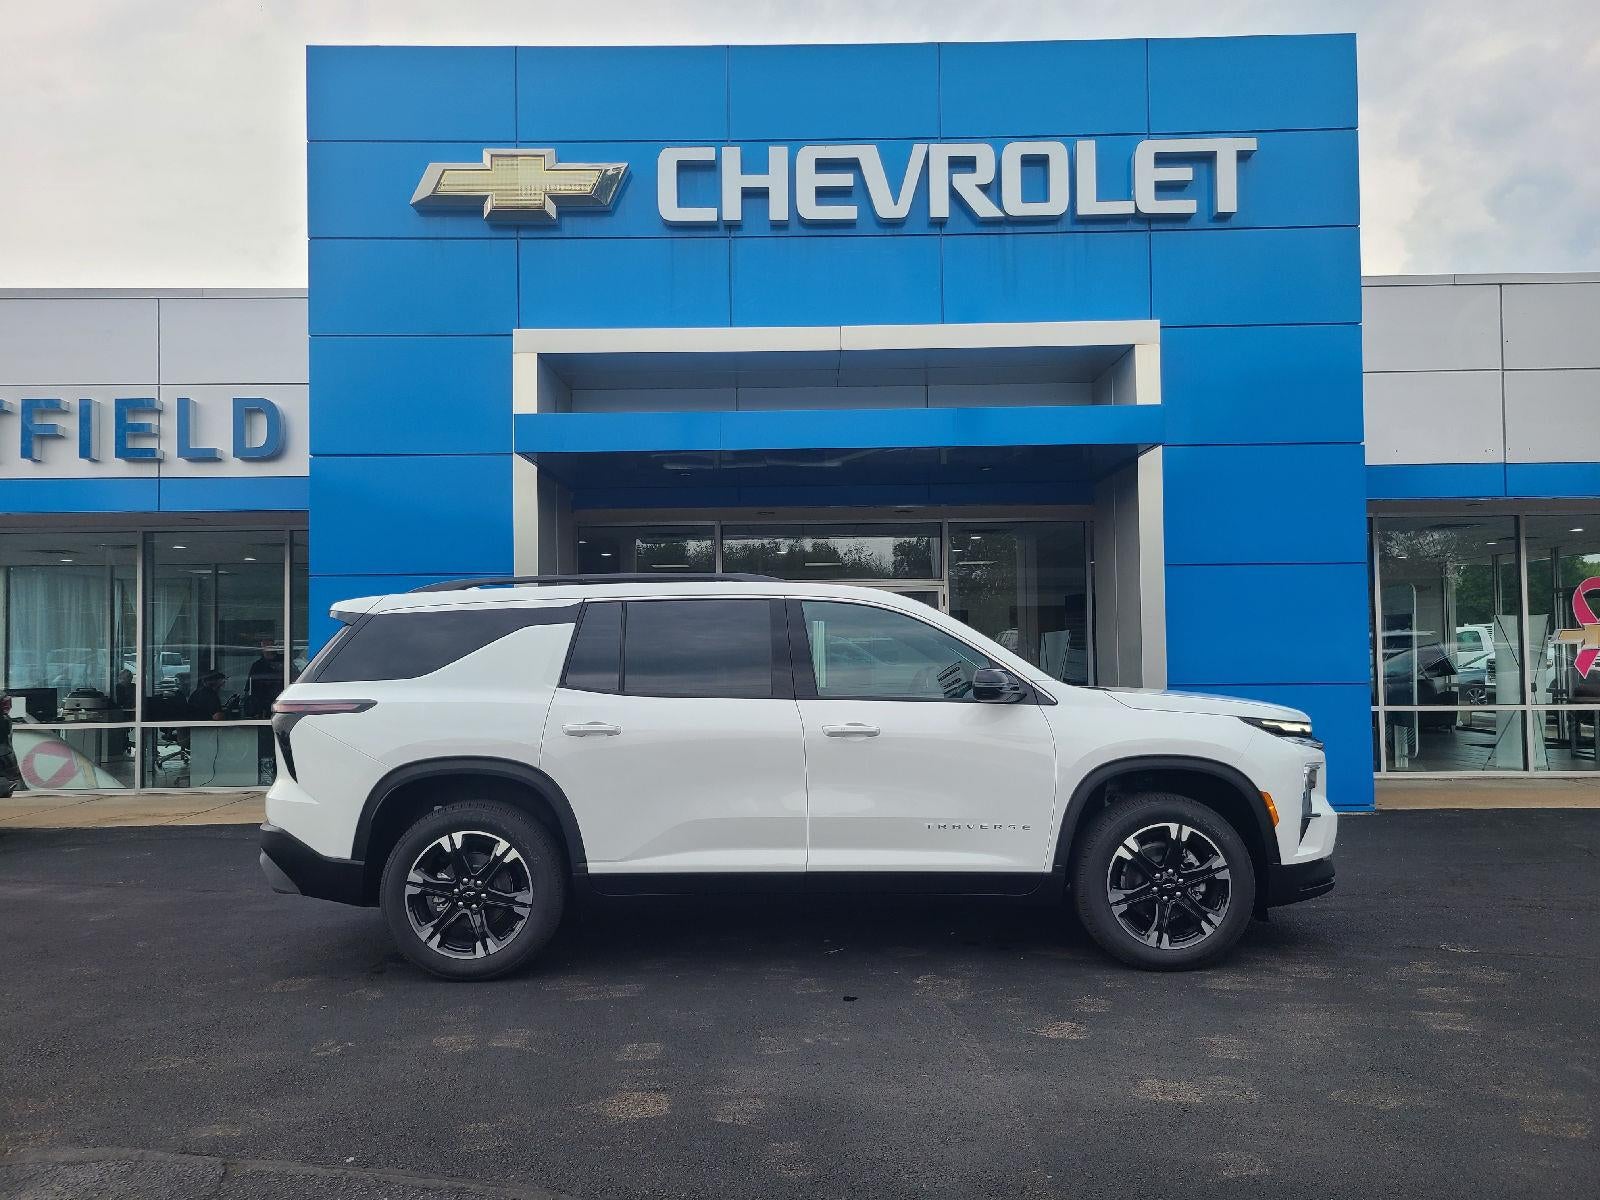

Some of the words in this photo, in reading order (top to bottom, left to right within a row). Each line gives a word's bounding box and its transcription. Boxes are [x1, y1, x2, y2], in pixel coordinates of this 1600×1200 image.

[657, 137, 1258, 225] CHEVROLET
[0, 397, 286, 463] FIELD
[925, 822, 1032, 832] TRAVERSE
